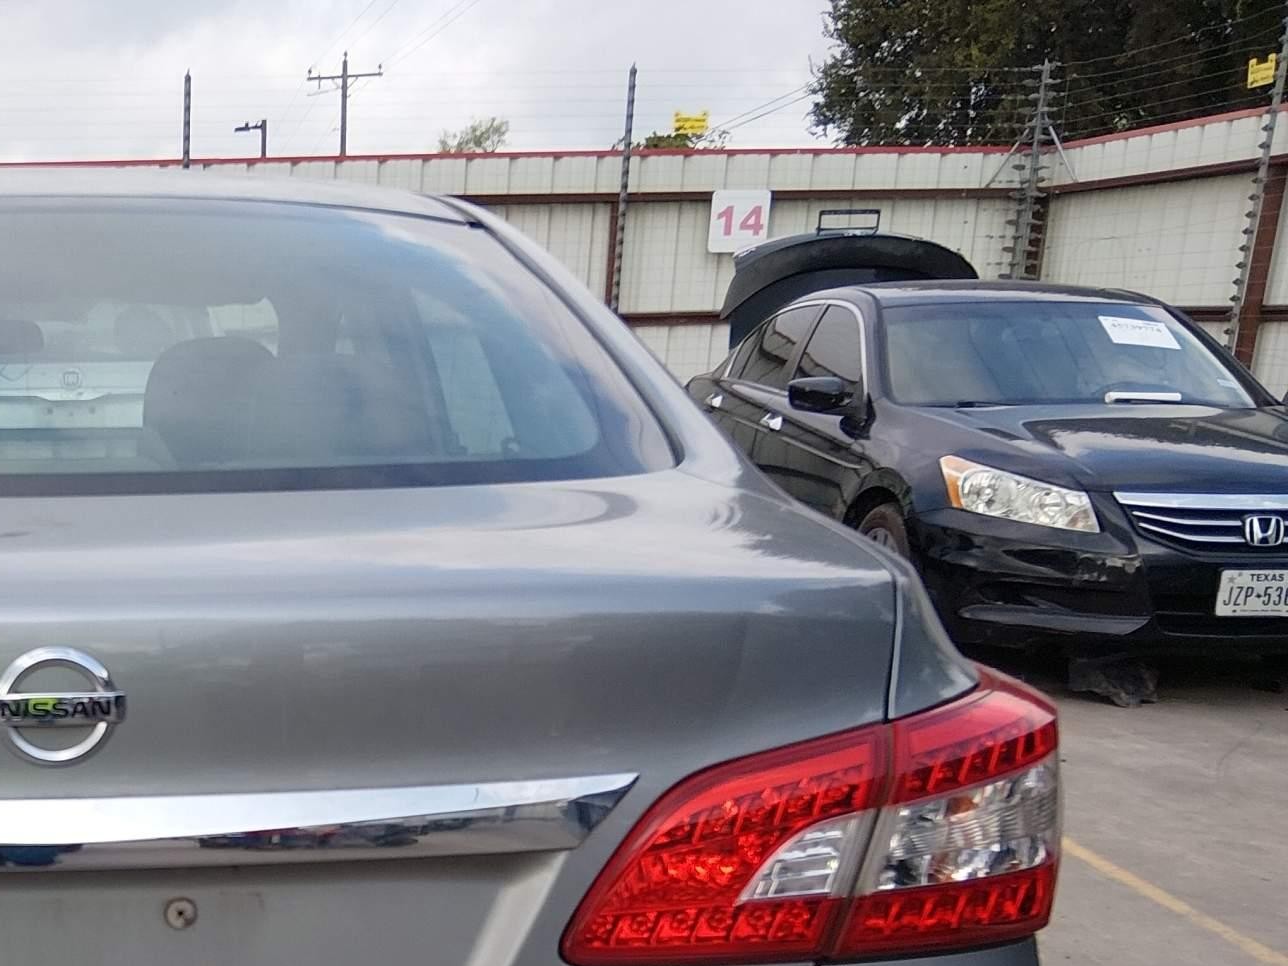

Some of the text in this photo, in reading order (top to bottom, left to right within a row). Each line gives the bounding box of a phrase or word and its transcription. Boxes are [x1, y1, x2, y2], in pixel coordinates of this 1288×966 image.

[717, 205, 764, 236] 14
[1250, 573, 1285, 582] TEXAS
[0, 700, 111, 718] NISSAN
